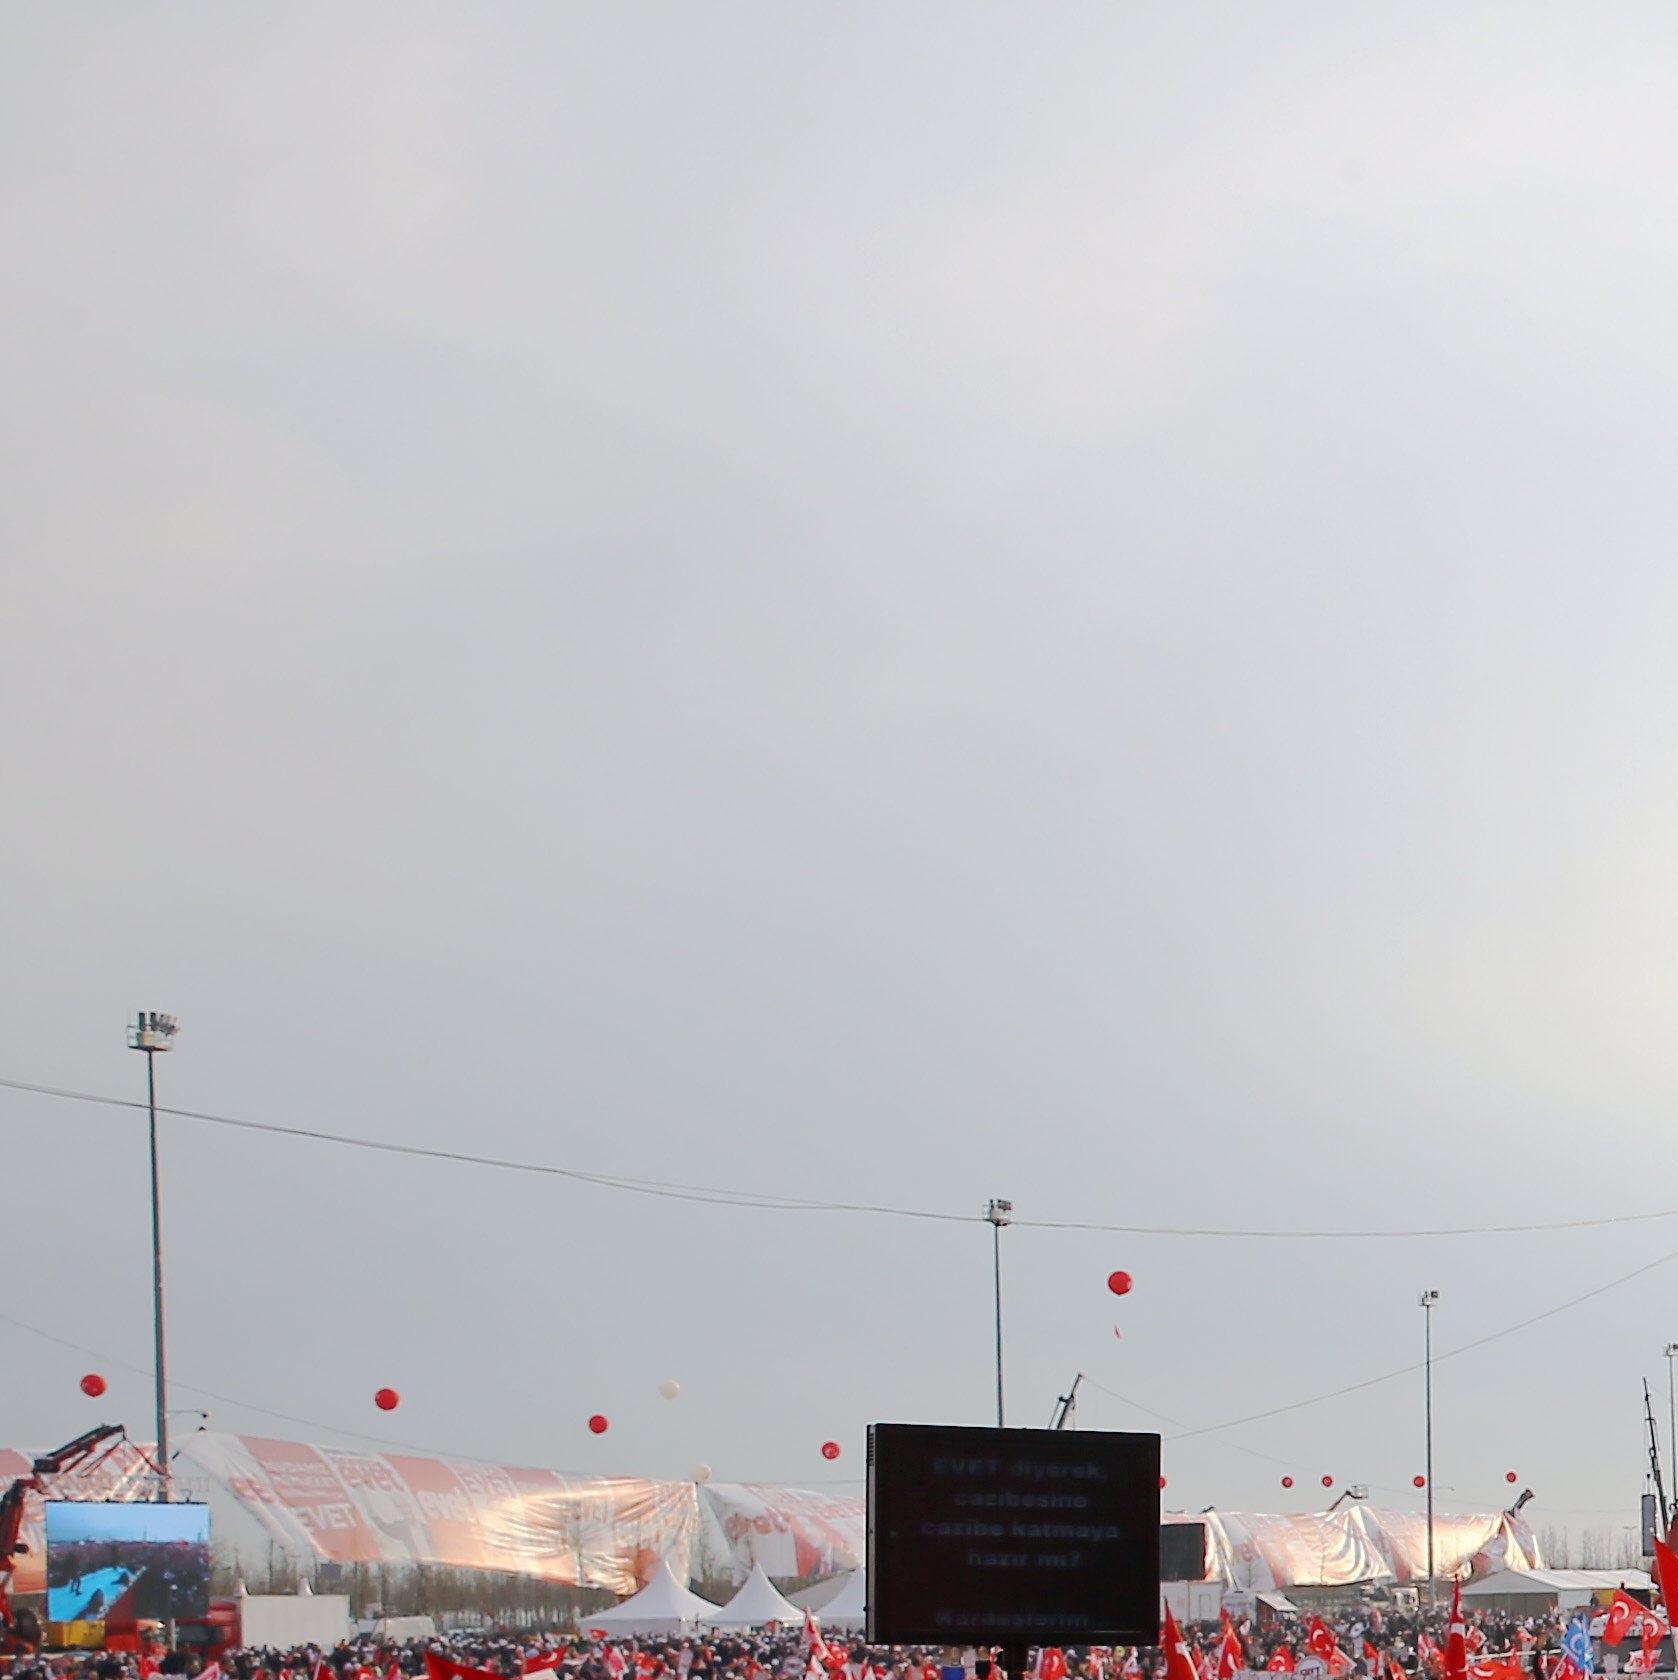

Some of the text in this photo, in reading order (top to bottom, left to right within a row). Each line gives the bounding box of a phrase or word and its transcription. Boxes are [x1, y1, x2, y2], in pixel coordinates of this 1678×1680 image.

[932, 1457, 999, 1477] EVET
[953, 1491, 1089, 1510] cazibesine
[920, 1519, 1120, 1544] cazibe katmaya
[966, 1547, 1082, 1567] hazır mı?
